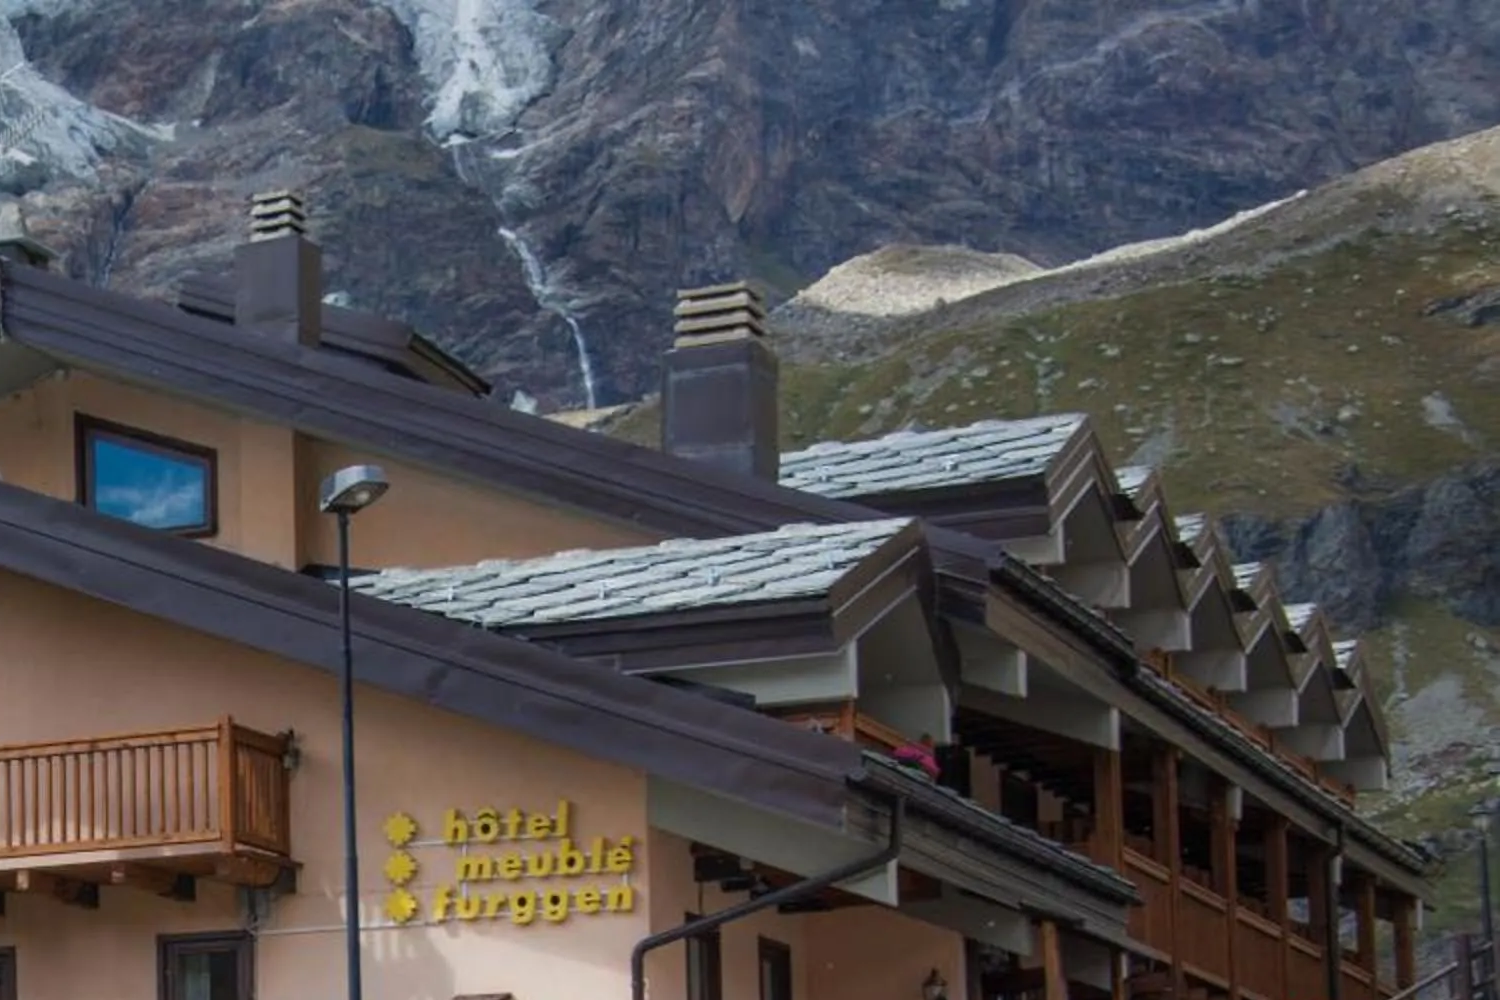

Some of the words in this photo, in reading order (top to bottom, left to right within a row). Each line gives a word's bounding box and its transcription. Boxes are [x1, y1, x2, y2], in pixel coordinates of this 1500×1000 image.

[444, 799, 569, 843] hôtel
[456, 836, 634, 881] meublé
[433, 886, 634, 925] furggen
